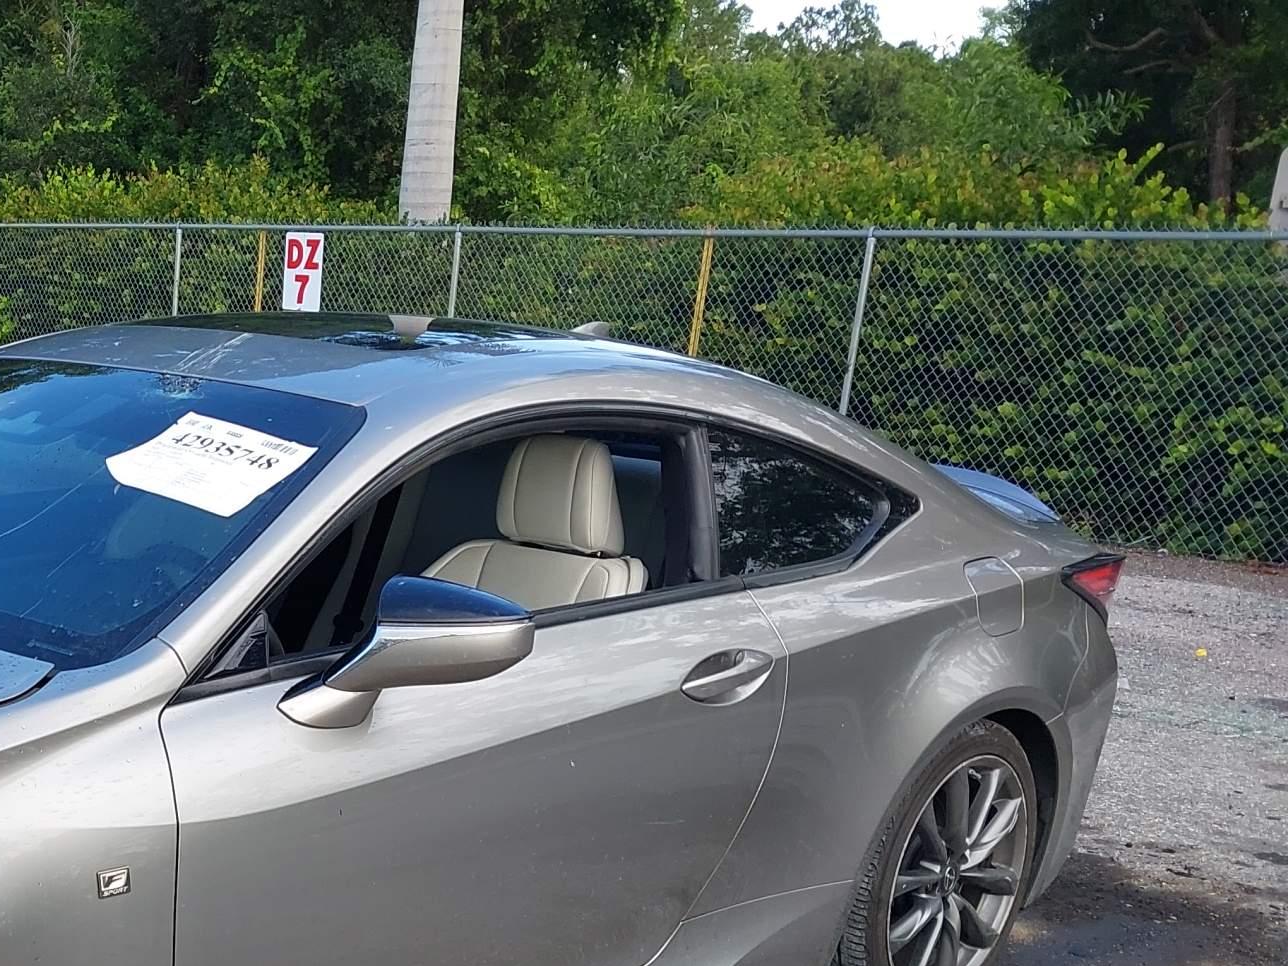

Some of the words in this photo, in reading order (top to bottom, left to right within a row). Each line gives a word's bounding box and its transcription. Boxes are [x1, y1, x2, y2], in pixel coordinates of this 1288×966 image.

[287, 239, 321, 270] DZ
[295, 275, 310, 304] 7
[171, 432, 280, 470] 42935748
[103, 886, 129, 897] SPORT
